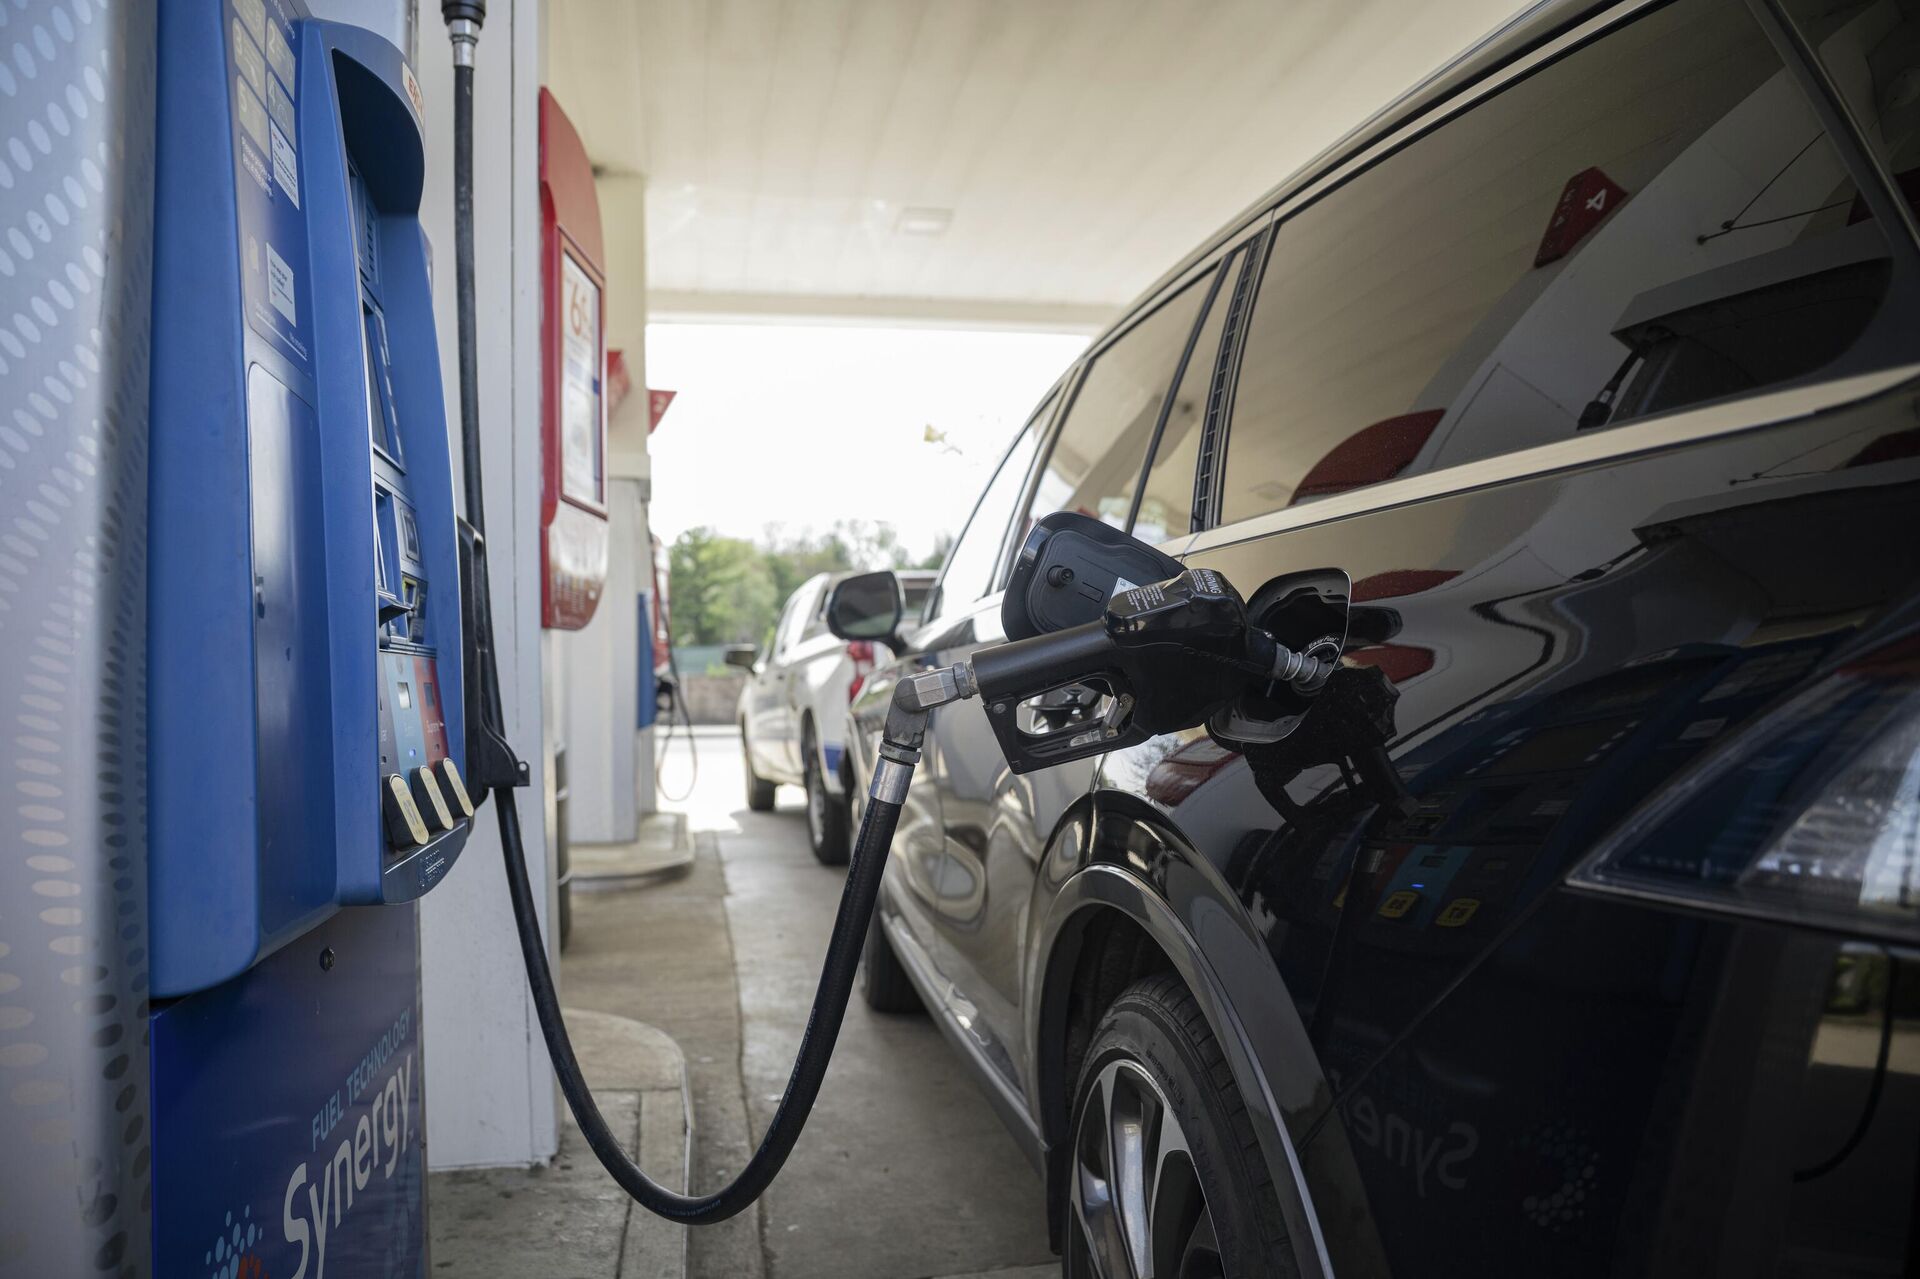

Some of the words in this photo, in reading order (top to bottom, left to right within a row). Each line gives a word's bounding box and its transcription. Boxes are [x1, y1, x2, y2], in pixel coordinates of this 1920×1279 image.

[1201, 569, 1222, 595] WARNING
[312, 1089, 345, 1153] FUEL
[346, 1006, 411, 1107] TECHNOLOGY
[283, 1053, 412, 1279] Synergy
